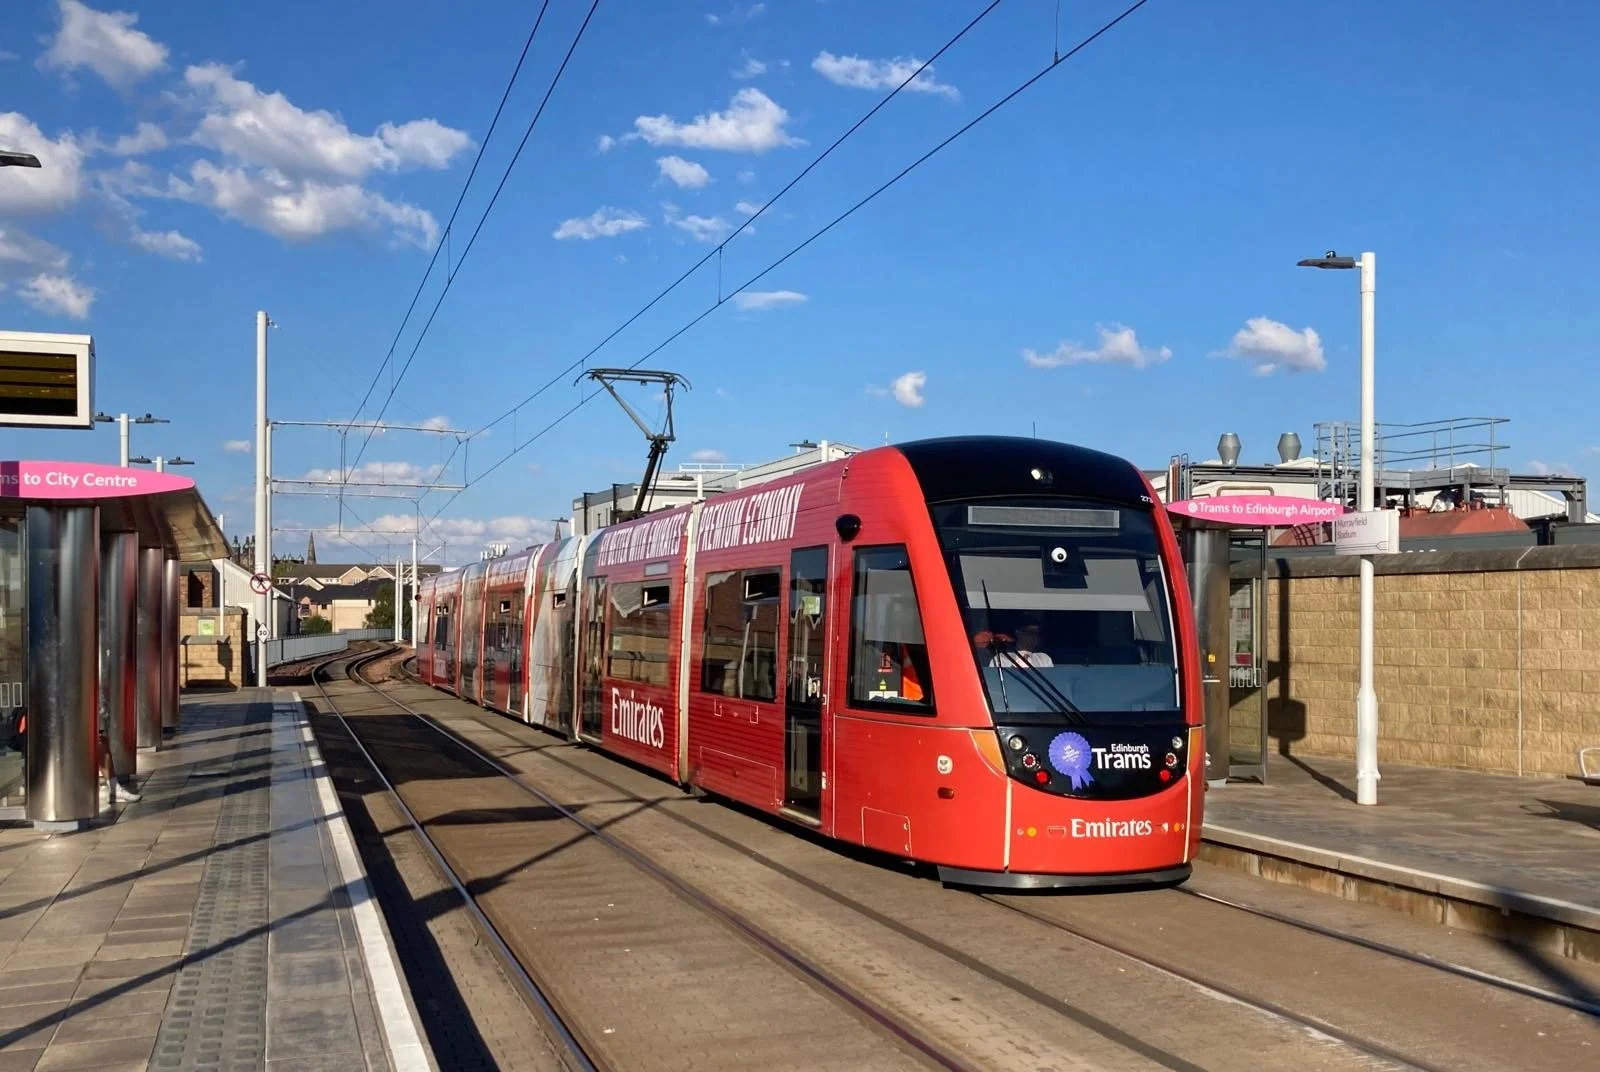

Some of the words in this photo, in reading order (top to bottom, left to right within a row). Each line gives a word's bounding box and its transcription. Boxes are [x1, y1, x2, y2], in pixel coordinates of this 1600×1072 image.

[24, 472, 41, 485] to
[45, 472, 79, 488] City
[82, 473, 138, 487] Centre
[696, 497, 747, 553] PREMIUM
[742, 482, 805, 545] ECONOMY
[1200, 502, 1229, 514] Trams
[1232, 504, 1243, 514] to
[1246, 503, 1298, 517] Edinburgh
[1300, 504, 1336, 517] Airport
[1336, 515, 1368, 529] Murrayfield
[611, 687, 664, 749] Emirates
[1091, 747, 1152, 769] Trams
[1110, 743, 1149, 755] Edinburgh
[1071, 816, 1153, 838] Emirates
